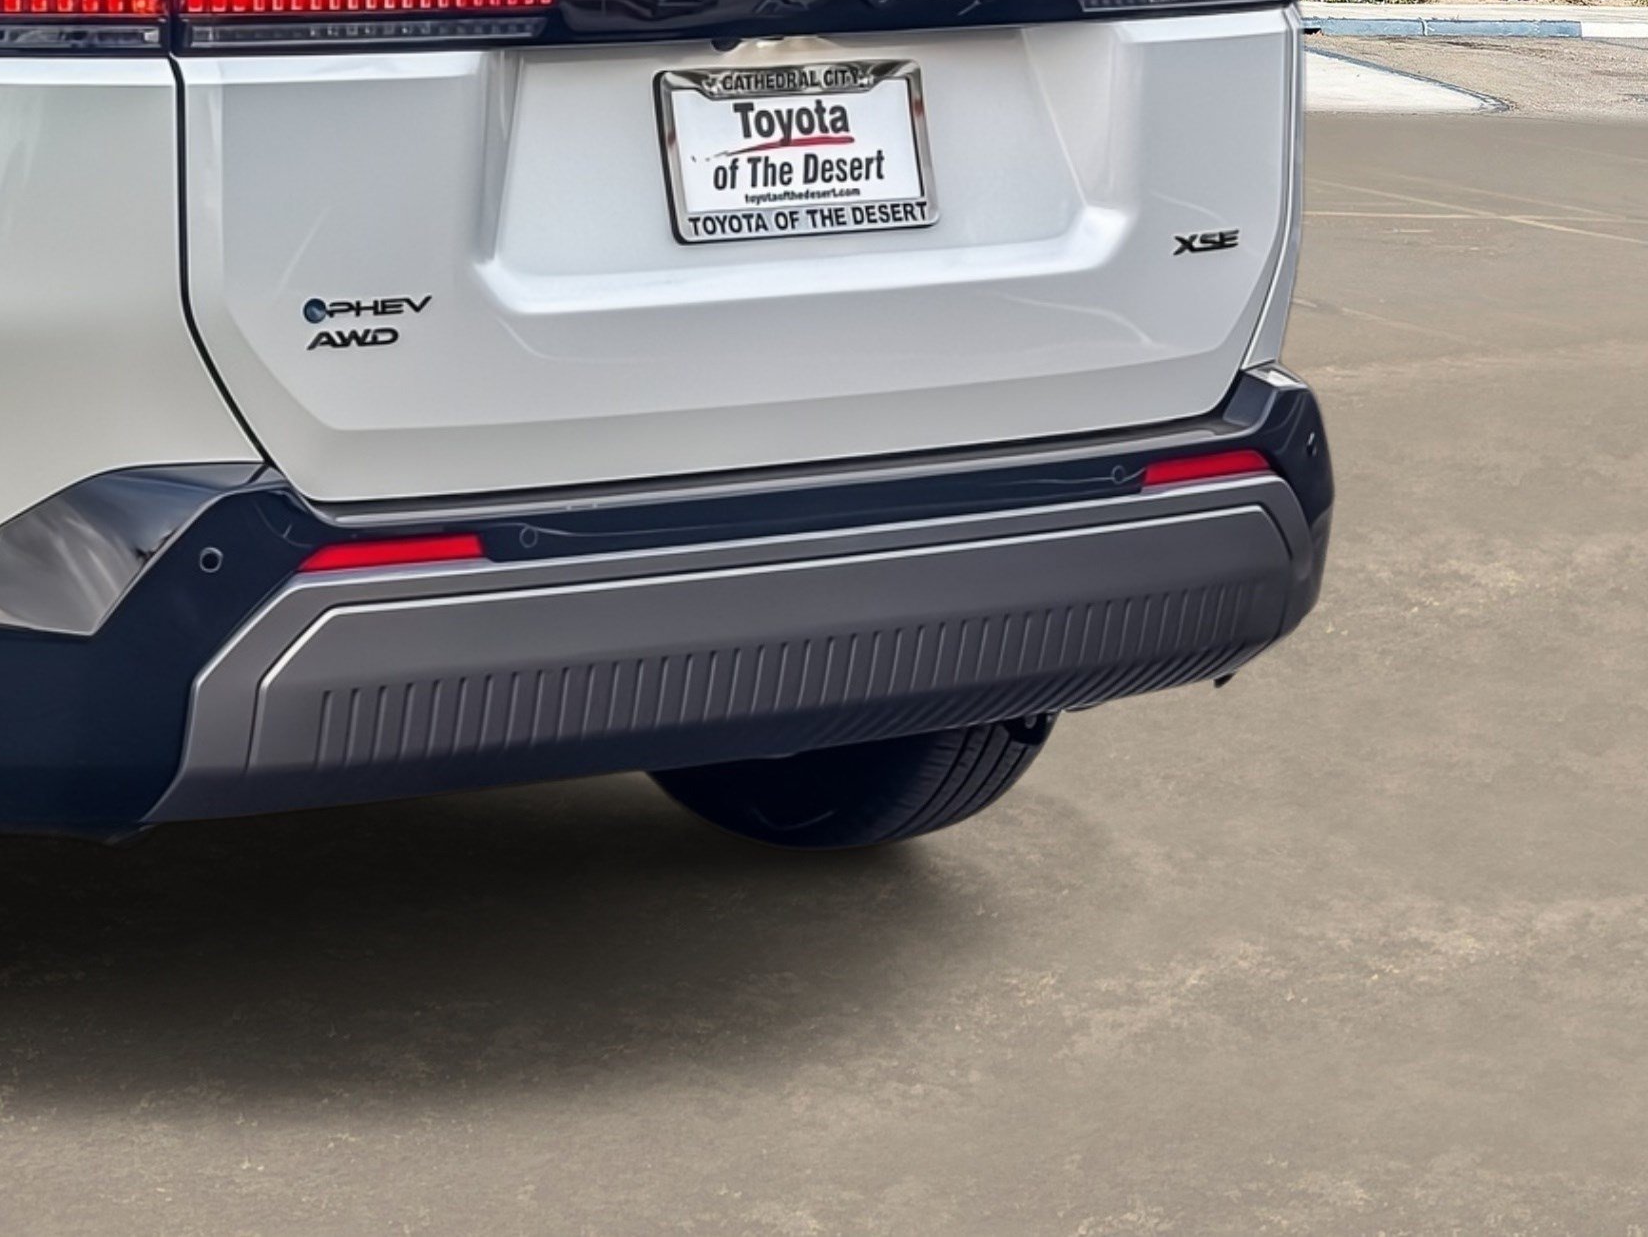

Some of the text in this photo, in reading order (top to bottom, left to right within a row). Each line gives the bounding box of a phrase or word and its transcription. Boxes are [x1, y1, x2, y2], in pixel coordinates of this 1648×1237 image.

[722, 66, 859, 91] CATHEDRAL CITY
[733, 99, 851, 146] Toyota
[713, 150, 885, 191] of The Desert
[745, 187, 861, 205] toyotaofthedesert.com
[688, 201, 928, 236] TOYOTA OF THE DESERT
[1172, 229, 1240, 255] XSE
[327, 295, 433, 318] PHEV
[307, 327, 399, 350] AWD
